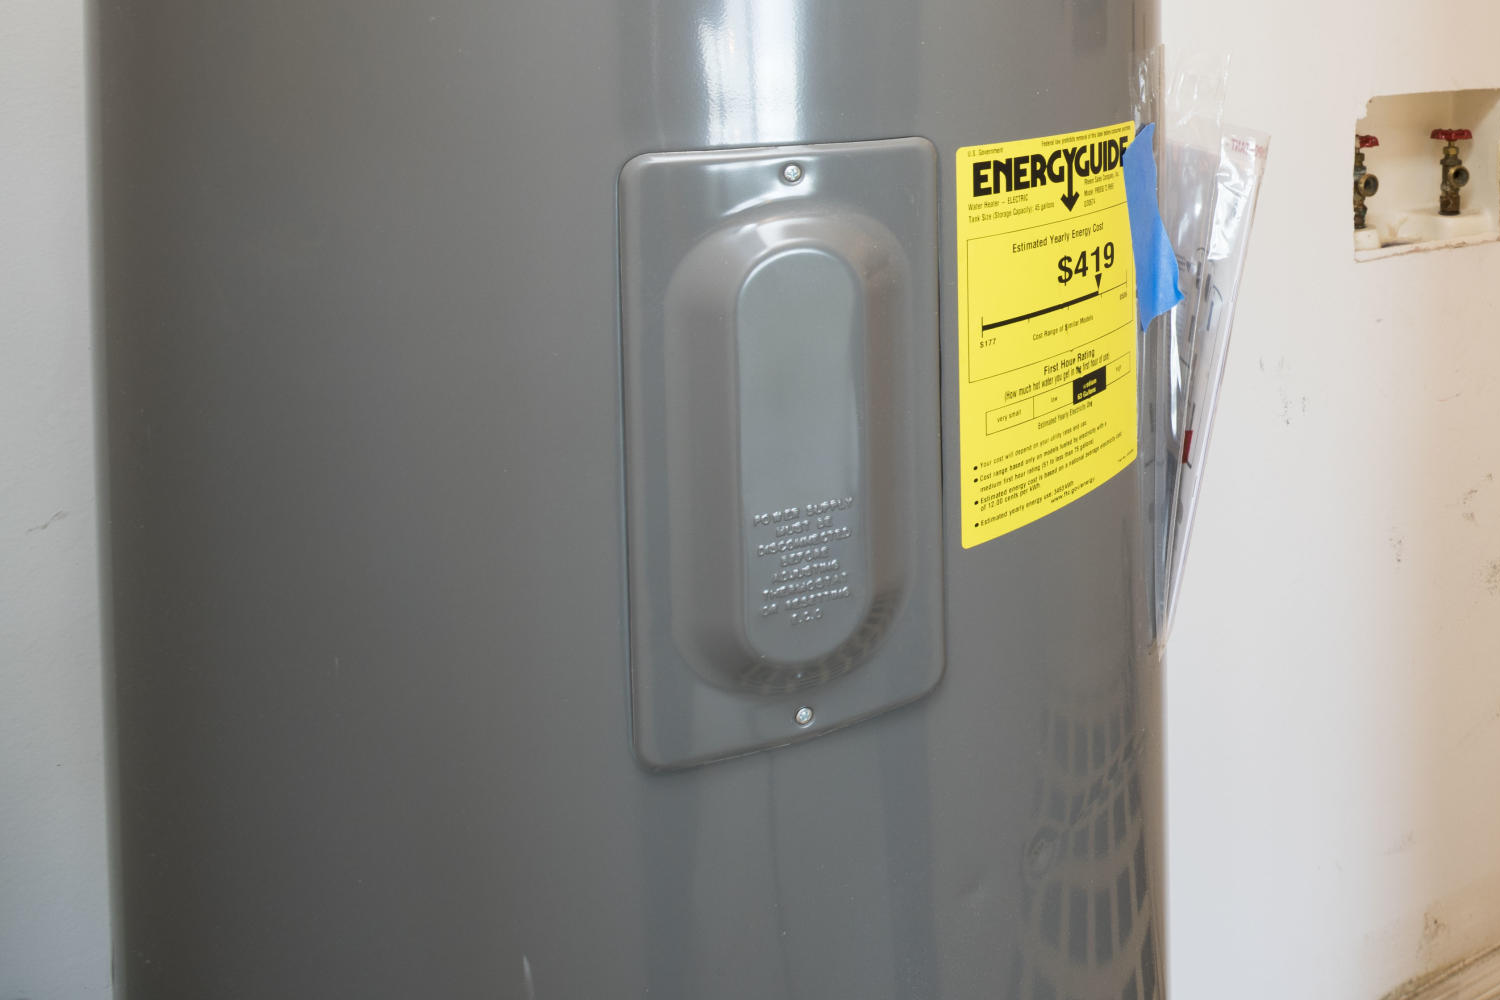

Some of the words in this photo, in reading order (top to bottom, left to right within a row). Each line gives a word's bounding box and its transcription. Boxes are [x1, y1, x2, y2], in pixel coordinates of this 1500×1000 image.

[968, 203, 982, 211] Water
[984, 200, 999, 208] Heater
[1008, 193, 1028, 204] ELECTRIC
[968, 215, 980, 223] Tank
[982, 213, 991, 221] Size
[1012, 237, 1048, 253] Estimated
[1050, 232, 1070, 245] Yearly
[1072, 226, 1092, 239] Energy
[1092, 222, 1104, 233] Cost
[1057, 241, 1115, 286] $419
[1032, 333, 1043, 341] Cost
[1044, 327, 1058, 338] Range
[1064, 320, 1079, 332] Similar
[1080, 315, 1094, 324] Models
[1044, 363, 1059, 376] First
[1061, 357, 1076, 370] Hour
[1078, 349, 1095, 362] Rating
[1019, 384, 1031, 396] much
[1042, 377, 1054, 388] water
[997, 415, 1007, 423] very
[1009, 409, 1021, 419] small
[980, 460, 991, 468] Your
[1015, 445, 1032, 456] depend
[1040, 438, 1049, 446] your
[1050, 433, 1061, 441] utility
[980, 473, 991, 481] Cost
[993, 468, 1007, 476] range
[1010, 460, 1024, 470] based
[1044, 446, 1058, 456] models
[1060, 439, 1072, 449] fueled
[1079, 427, 1096, 440] electricity
[980, 489, 1007, 504] Estimated
[1009, 482, 1026, 493] energy
[1028, 476, 1037, 485] cost
[1044, 467, 1057, 478] based
[1069, 454, 1084, 466] national
[1085, 446, 1099, 457] average
[1100, 436, 1115, 449] electricity
[980, 481, 1001, 492] medium
[1004, 476, 1013, 484] first
[1015, 471, 1026, 479] hour
[1027, 465, 1040, 475] rating
[1005, 492, 1018, 502] cents
[1051, 478, 1095, 503] www.ftc.gov/energy
[753, 507, 800, 526] POWER
[806, 496, 853, 517] SUPPLY
[980, 511, 1007, 526] Estimated
[1009, 505, 1024, 516] yearly
[1026, 497, 1042, 507] energy
[776, 520, 810, 538] MUST
[817, 515, 834, 529] BE
[756, 526, 852, 558] DISCONNECTED
[780, 546, 830, 568] BEFORE
[772, 559, 841, 584] ADJUSTING
[762, 572, 848, 600] THERMOSTAT
[784, 586, 850, 611] RESETTING
